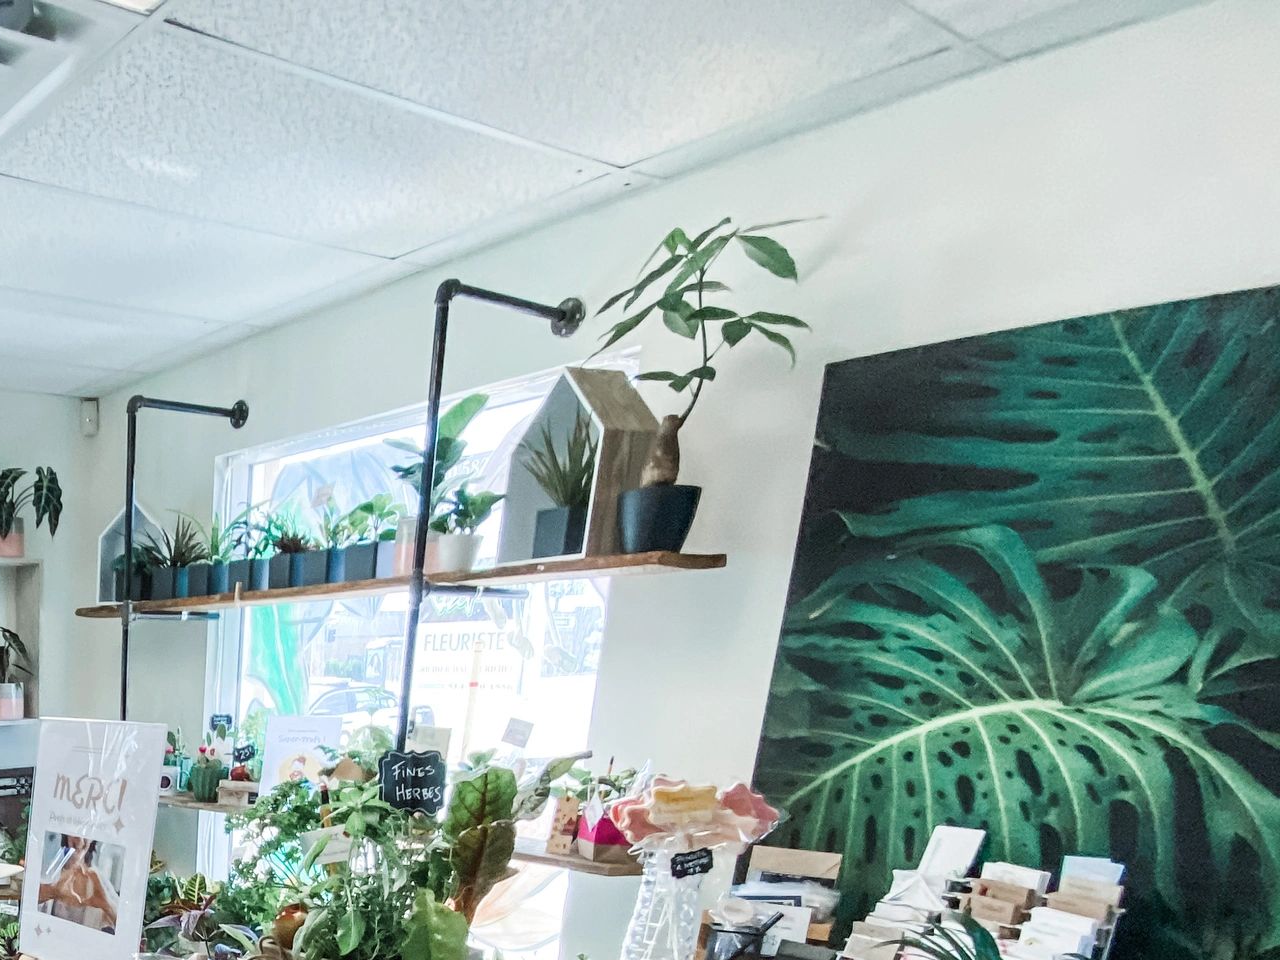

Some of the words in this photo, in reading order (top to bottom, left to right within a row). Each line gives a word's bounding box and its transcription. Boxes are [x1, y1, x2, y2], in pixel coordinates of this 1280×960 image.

[423, 631, 505, 652] FLEURISTE
[391, 760, 435, 780] FINES
[395, 783, 441, 802] HERBES
